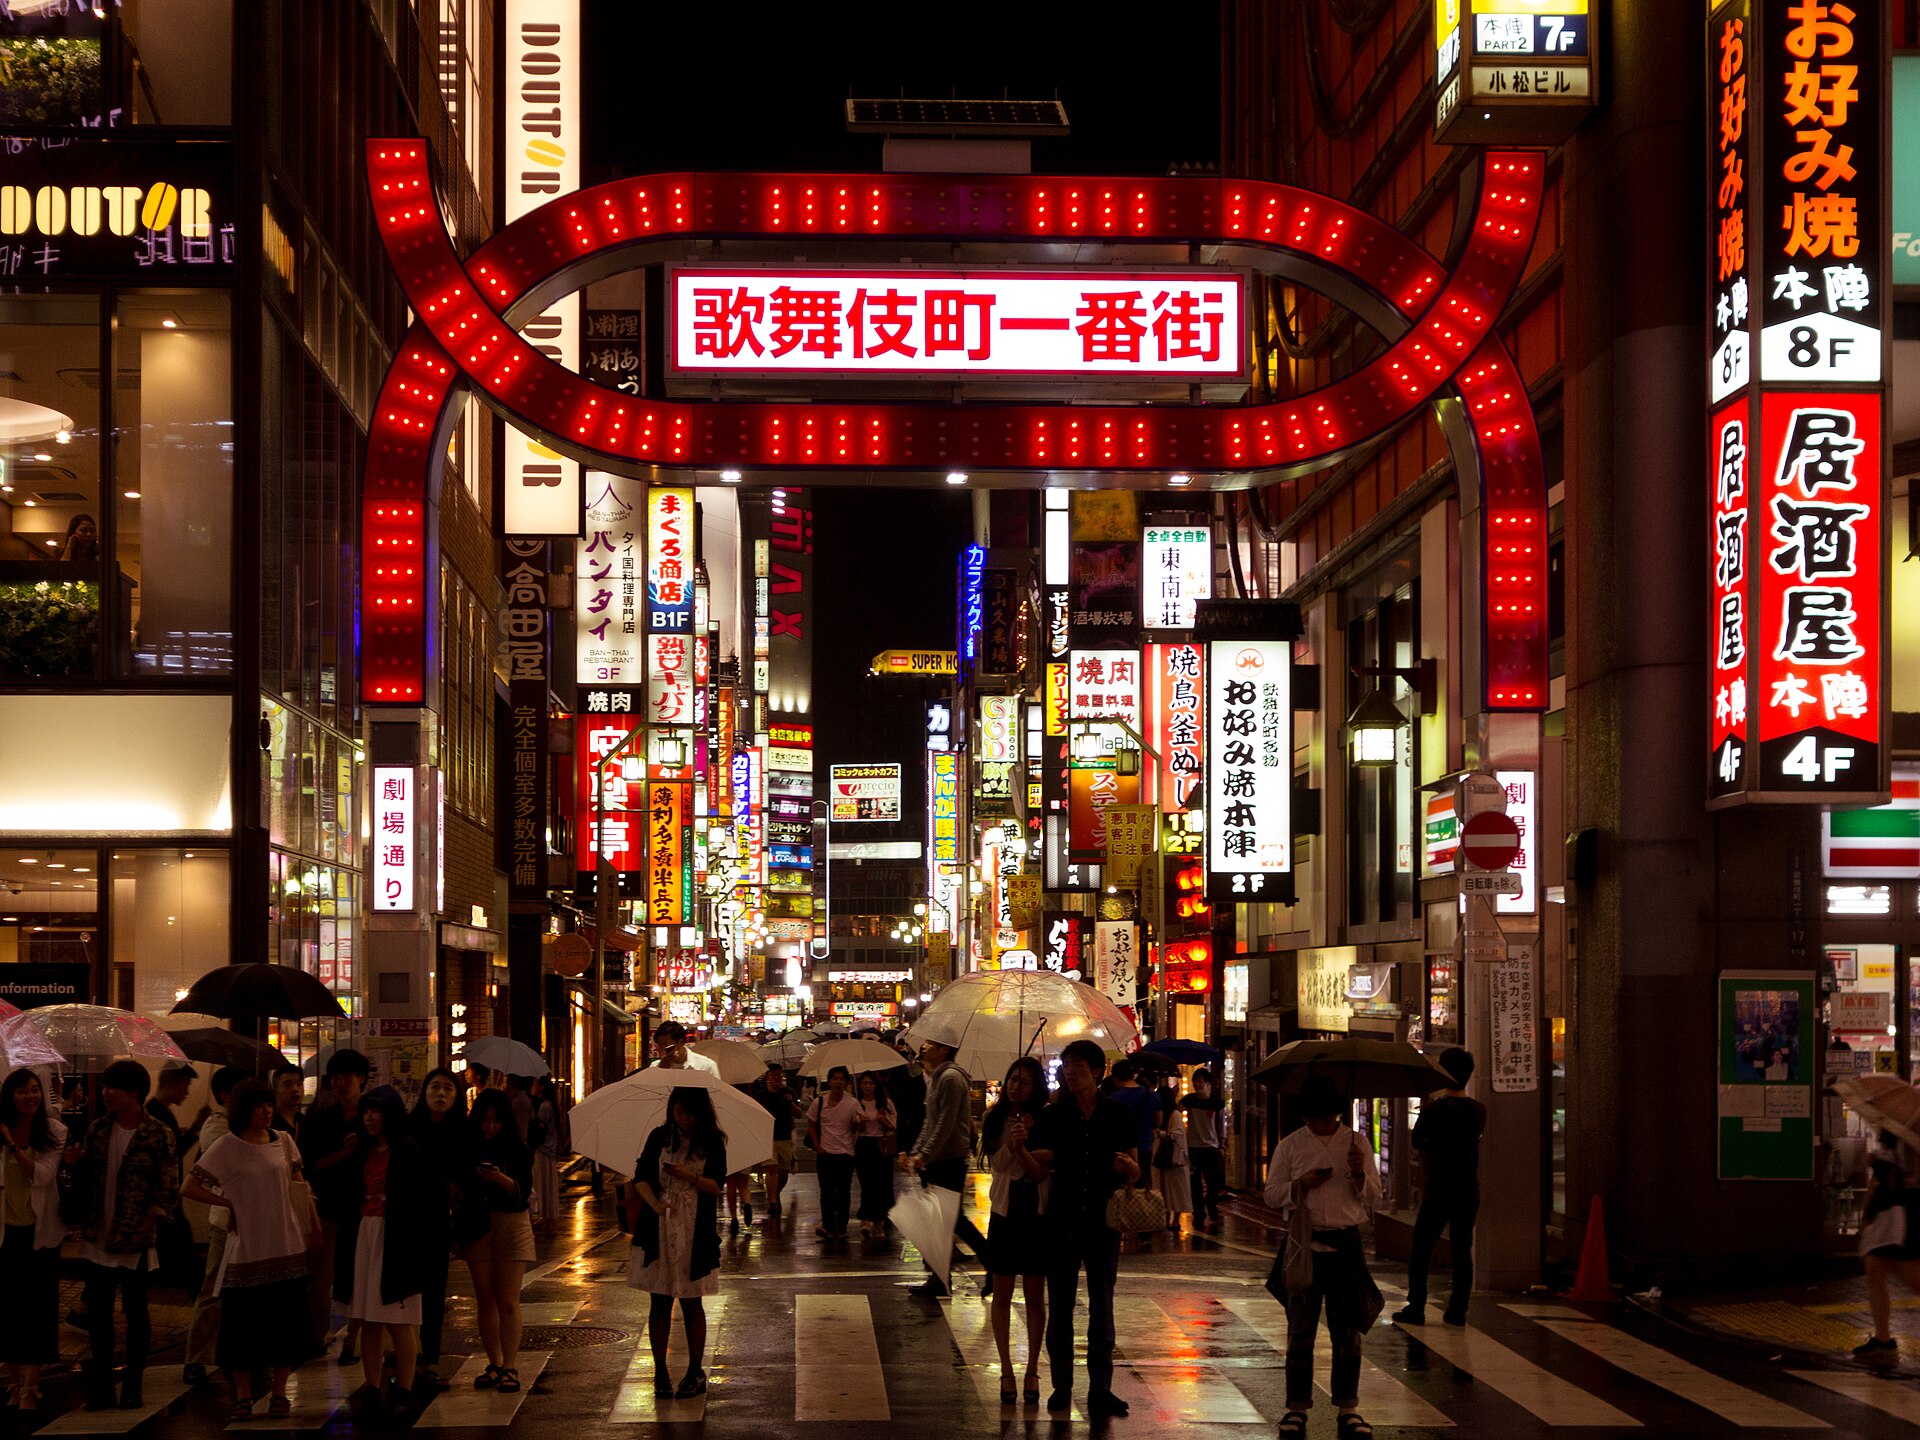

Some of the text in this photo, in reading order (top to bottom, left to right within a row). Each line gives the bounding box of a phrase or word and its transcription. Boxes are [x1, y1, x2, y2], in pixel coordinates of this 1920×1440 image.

[1484, 17, 1524, 36] 本陣
[1539, 16, 1577, 52] 7F
[1488, 70, 1572, 93] 小松ビル
[1716, 18, 1747, 284] お好み焼
[1780, 0, 1861, 259] お好み焼
[0, 181, 212, 238] DOUTOR
[1772, 263, 1871, 313] 本陣
[693, 286, 1224, 364] 歌舞伎町一番街
[1787, 326, 1855, 368] 8F
[1722, 342, 1743, 384] 8F
[658, 494, 683, 603] まぐろ商店
[1146, 530, 1207, 543] 全卓全自動
[1714, 419, 1748, 671] 居酒屋
[1769, 407, 1870, 667] 居酒屋
[585, 530, 616, 642] バンタイ
[621, 531, 635, 634] タイ国料理専門店
[1160, 547, 1181, 626] 東南荘
[504, 561, 547, 681] 高田屋
[651, 611, 689, 627] B1F
[597, 667, 621, 680] 3F
[911, 654, 942, 670] SUPER
[587, 691, 632, 713] 焼肉
[1769, 671, 1869, 721] 本陣
[1167, 646, 1202, 808] 焼鳥釜めし
[1222, 679, 1257, 859] お好み焼本陣
[1718, 739, 1742, 784] 4F
[1780, 736, 1856, 784] 4F
[513, 704, 537, 886] 完全個室多数完備
[382, 778, 406, 900] 劇場通り
[1167, 835, 1203, 853] 2F
[1231, 873, 1265, 894] 2F
[1465, 877, 1518, 890] 自転車を除く
[0, 981, 75, 994] nformation
[1507, 957, 1522, 1067] 防犯カメラ作動中
